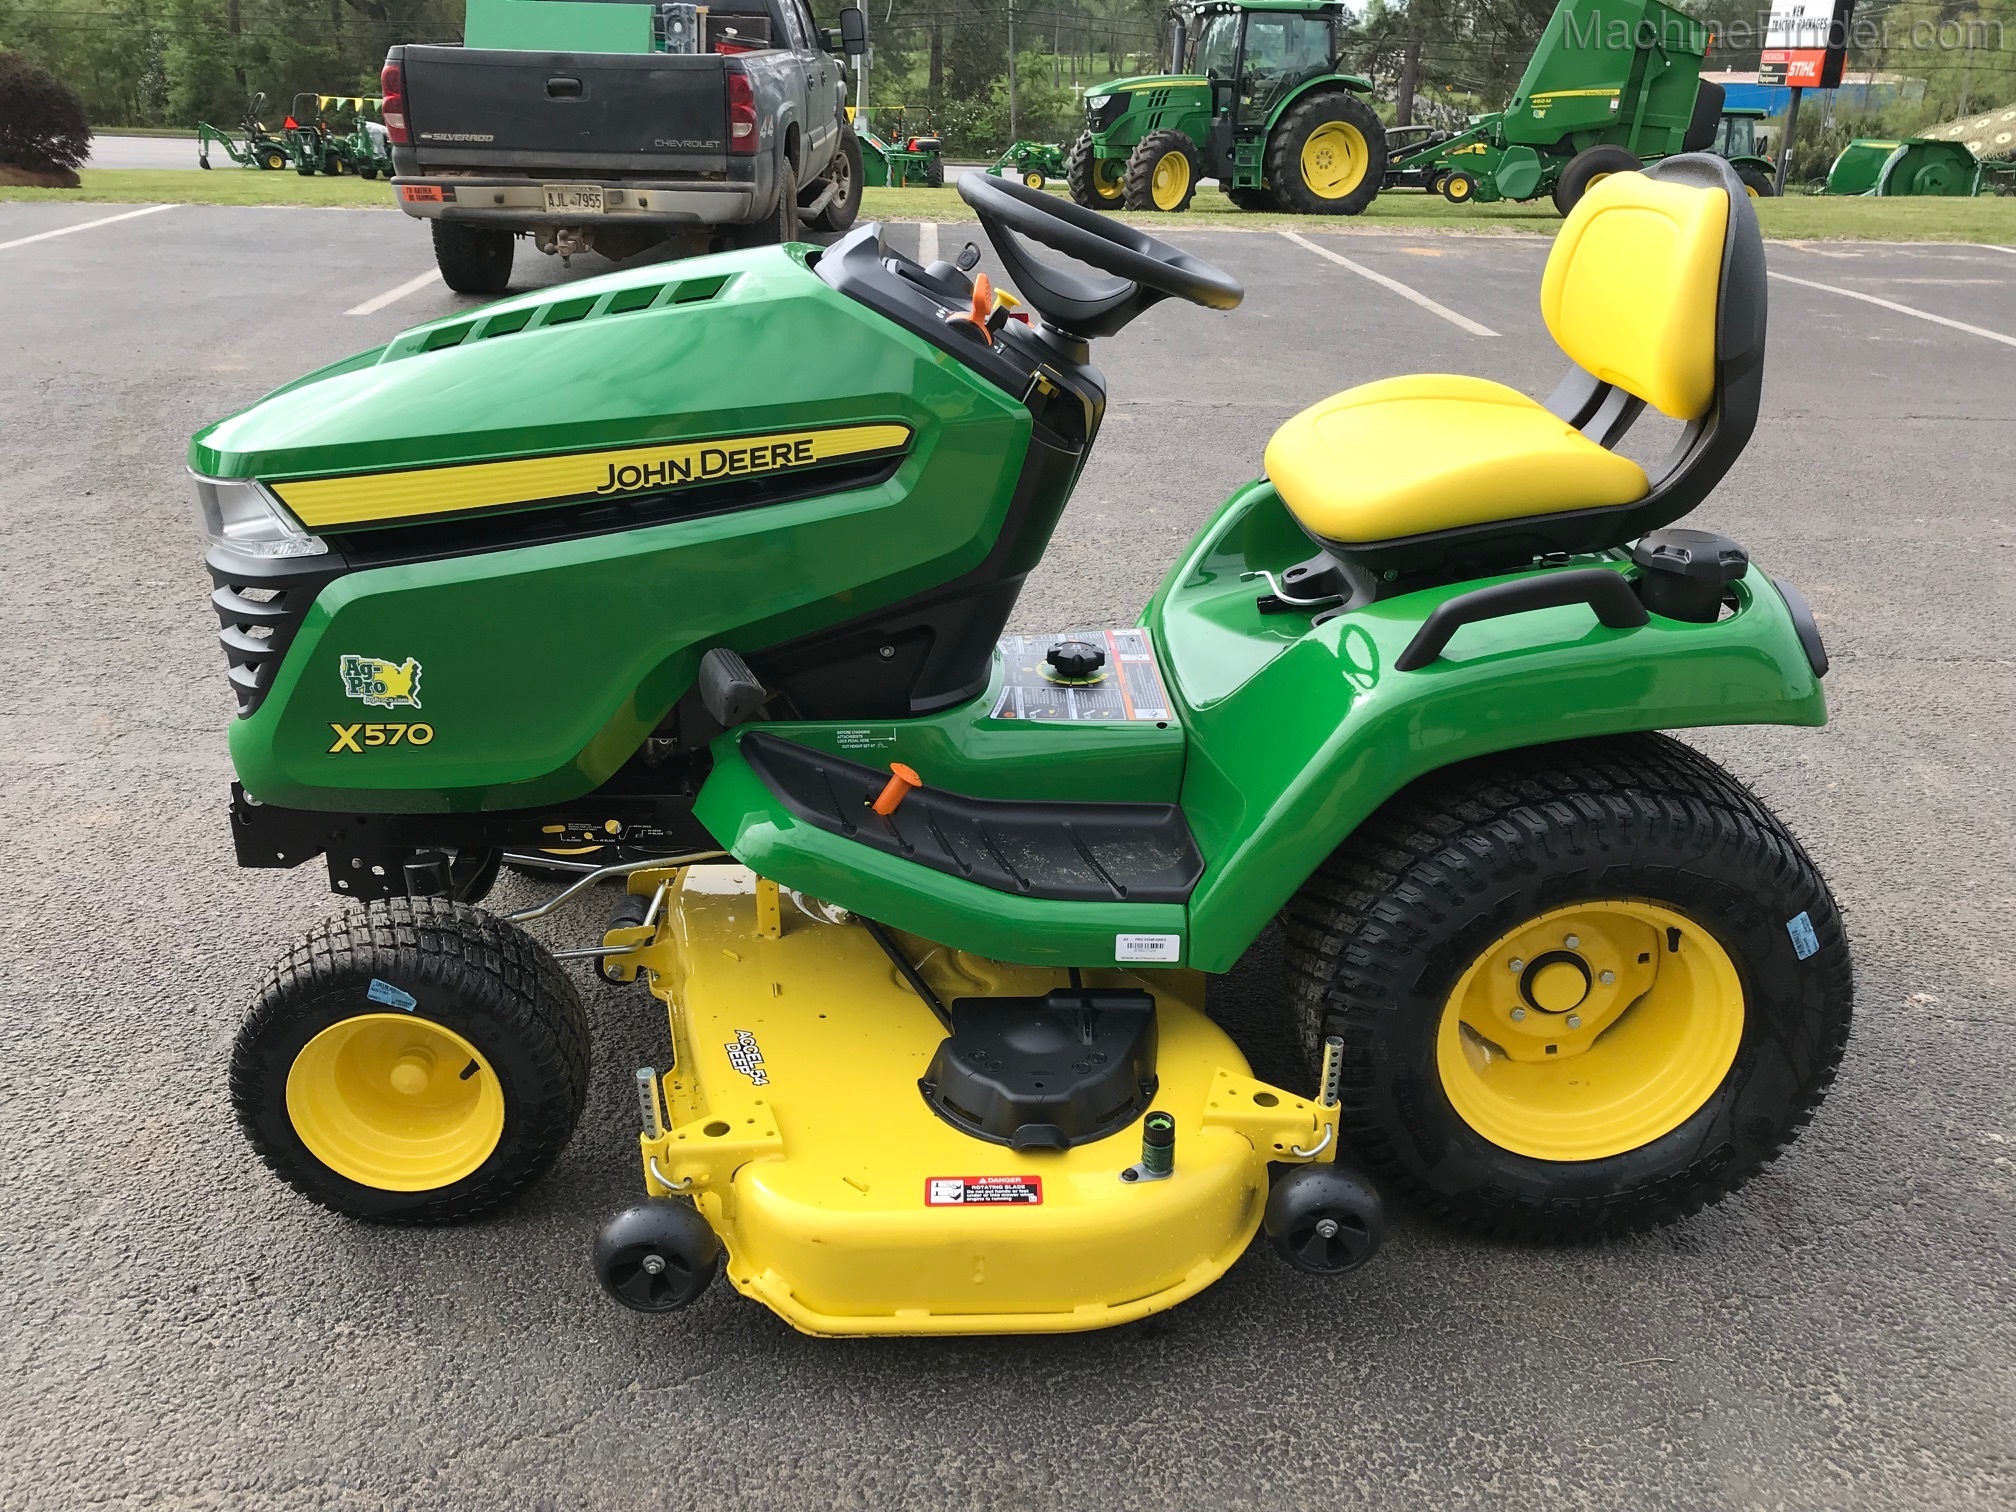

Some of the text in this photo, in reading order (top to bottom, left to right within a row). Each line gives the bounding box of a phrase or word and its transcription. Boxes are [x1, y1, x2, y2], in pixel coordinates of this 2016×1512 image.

[1792, 5, 1806, 17] NEW
[1763, 53, 1786, 61] HONDA
[1788, 61, 1816, 77] STIHL
[432, 133, 495, 142] SILVERADO
[654, 139, 721, 148] CHEVROLET
[548, 193, 602, 208] AJL 7955
[596, 438, 815, 493] JOHN DEERE
[345, 658, 383, 681] Ag-
[347, 676, 388, 696] Pro
[325, 722, 435, 755] X570
[724, 1042, 752, 1075] DEEP
[734, 1029, 770, 1086] ACCEL 54
